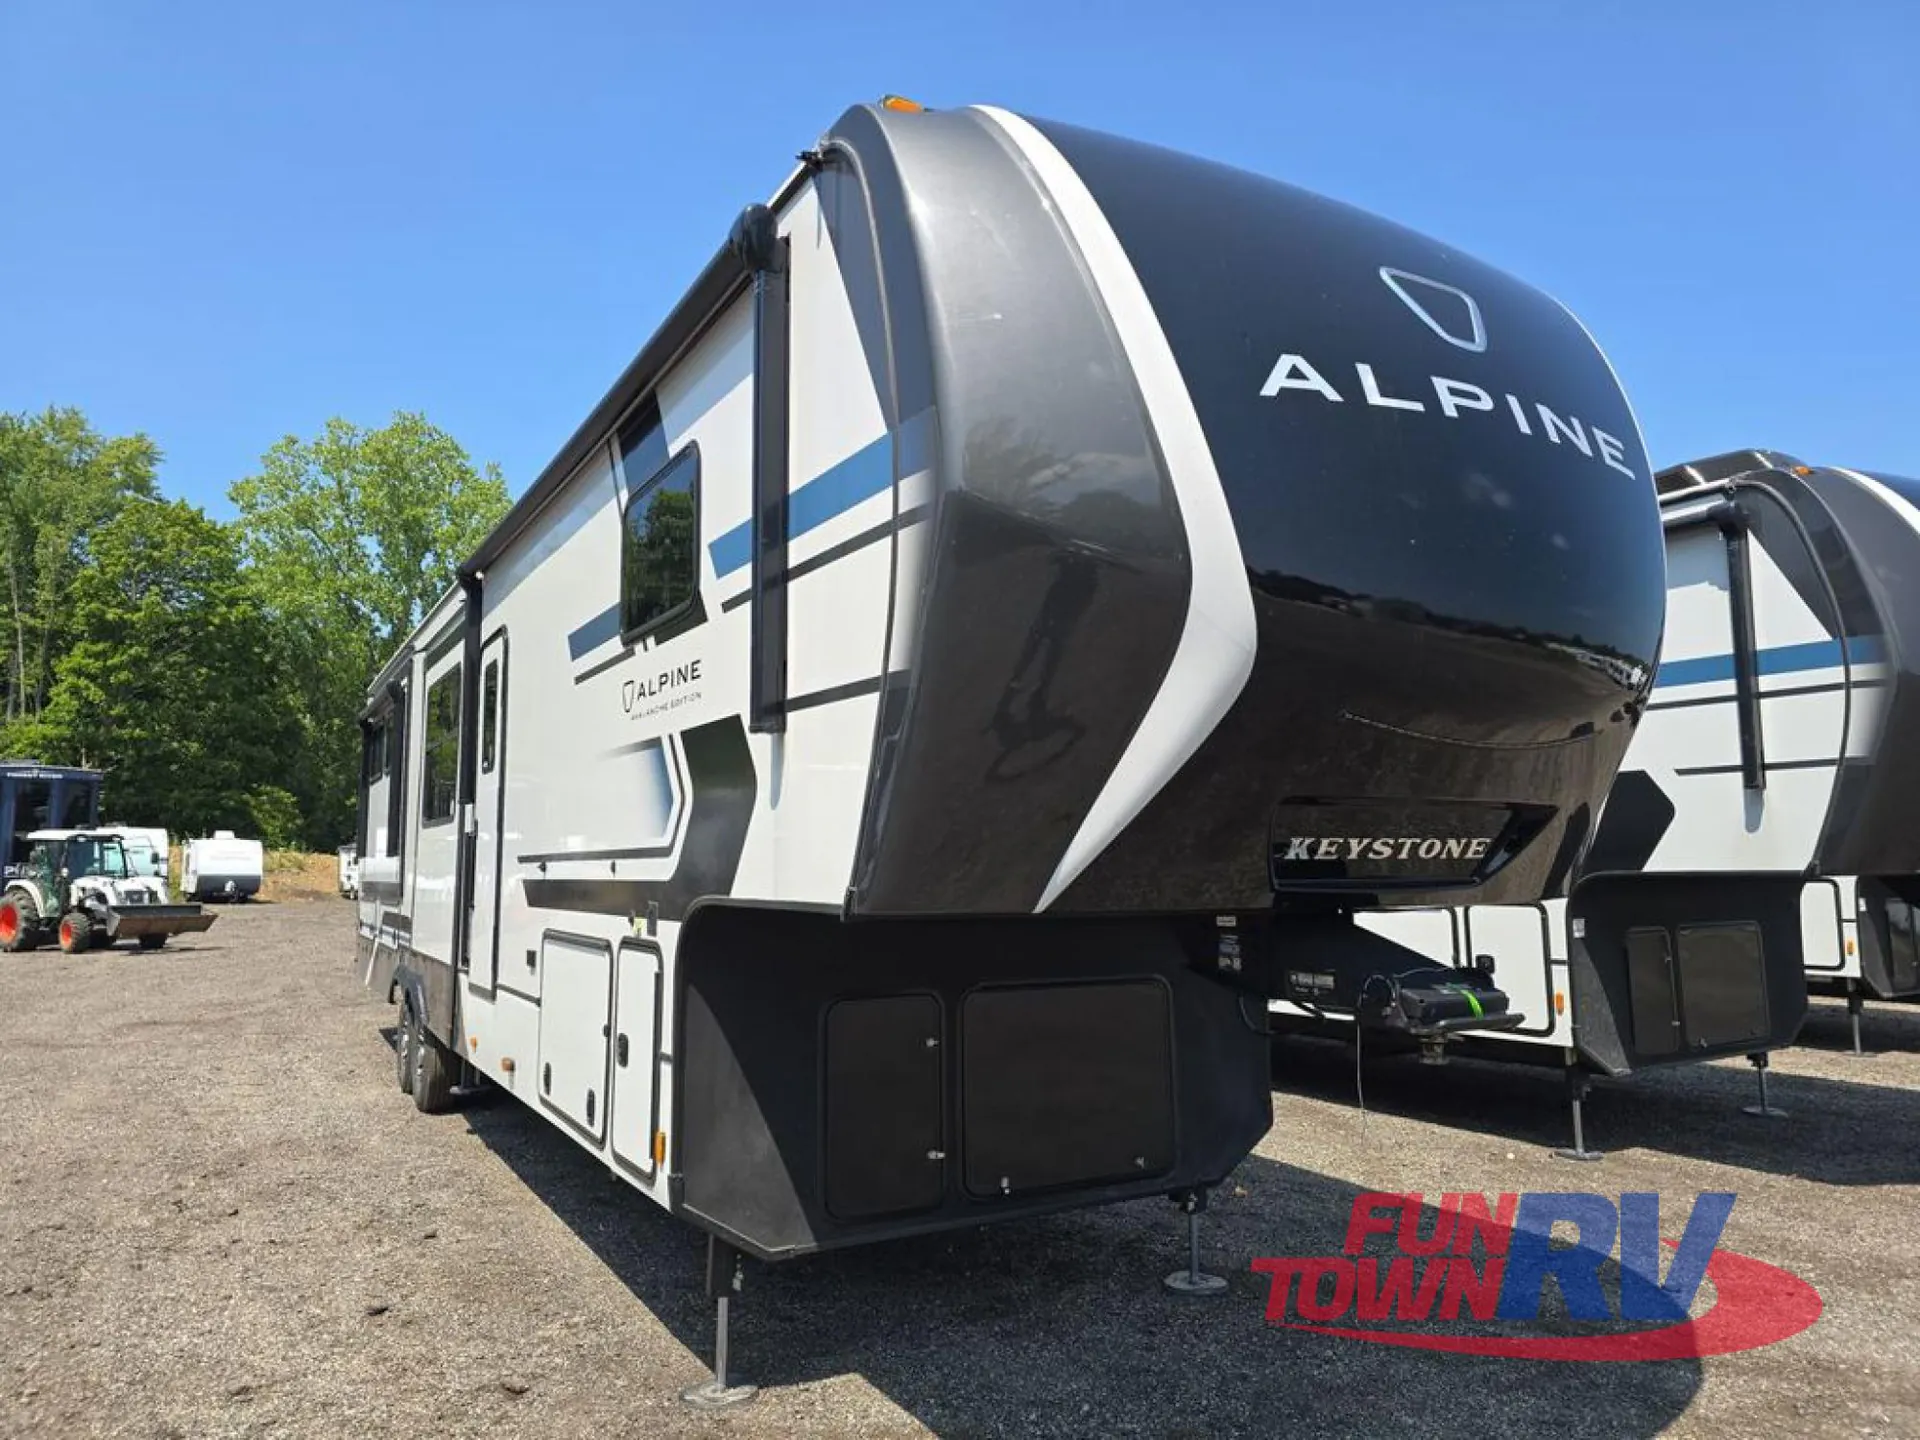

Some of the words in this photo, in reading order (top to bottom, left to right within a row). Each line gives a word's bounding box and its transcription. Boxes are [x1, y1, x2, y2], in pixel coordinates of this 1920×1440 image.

[1260, 353, 1635, 480] ALPINE
[638, 659, 702, 701] ALPINE
[1284, 838, 1492, 860] KEYSTONE
